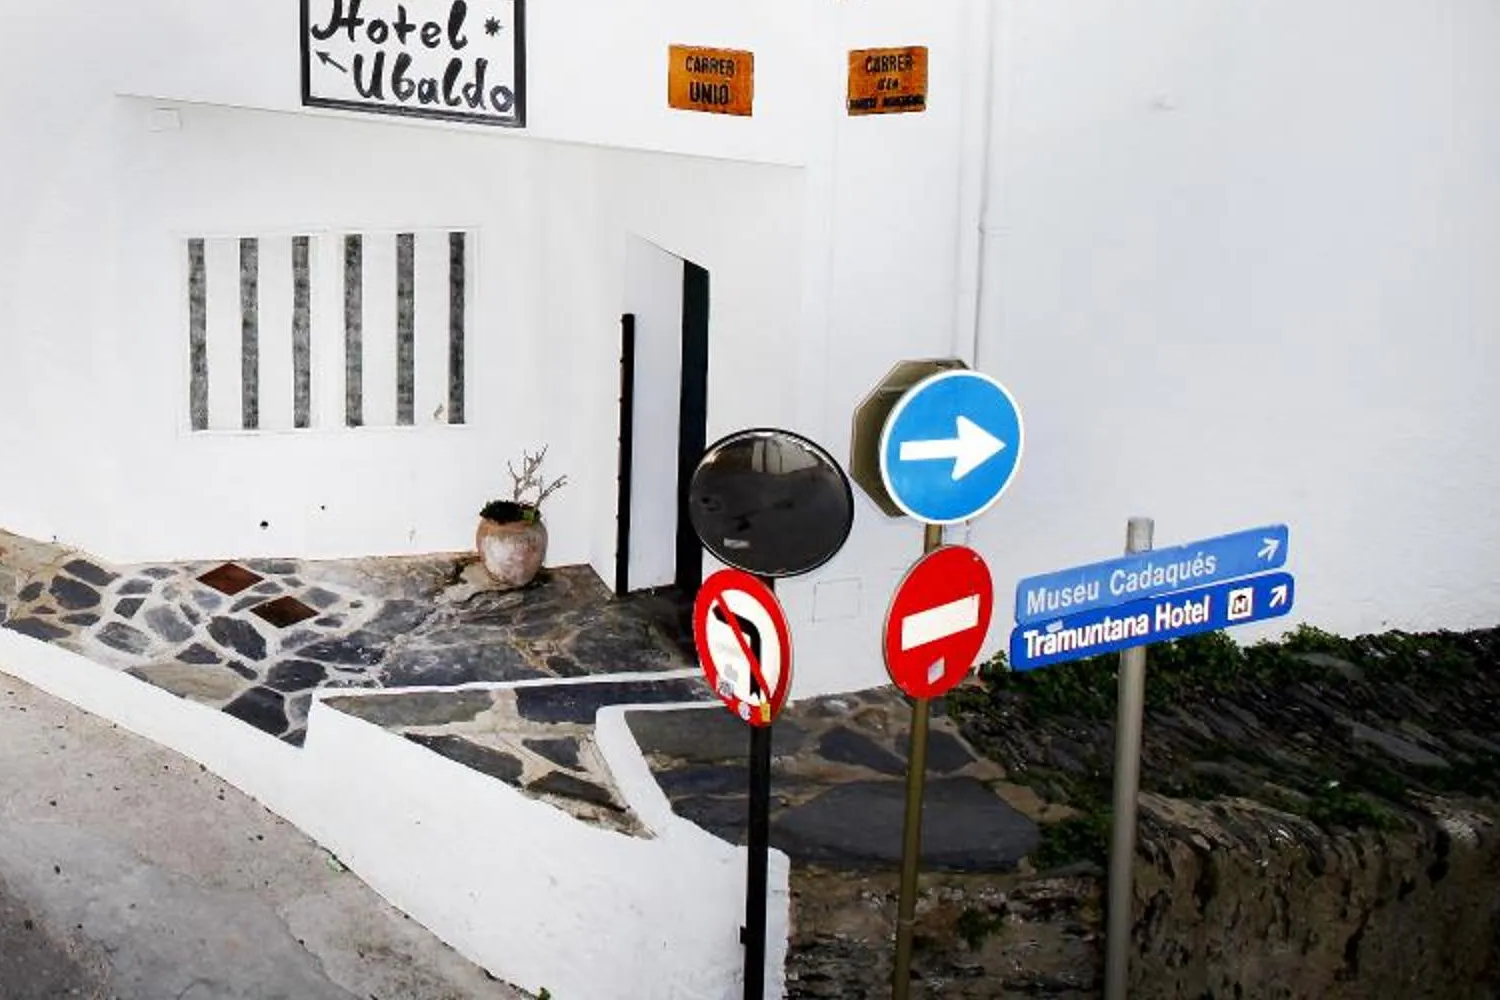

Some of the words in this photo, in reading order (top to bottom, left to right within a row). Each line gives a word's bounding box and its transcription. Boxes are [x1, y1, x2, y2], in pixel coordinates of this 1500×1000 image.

[353, 51, 516, 113] Ubaldo
[685, 55, 736, 78] CARRER
[865, 52, 914, 74] CARRER
[1026, 580, 1099, 616] Museu
[1109, 551, 1217, 597] Cadaqués
[1023, 612, 1150, 660] Tramuntana
[1155, 594, 1211, 632] Hotel
